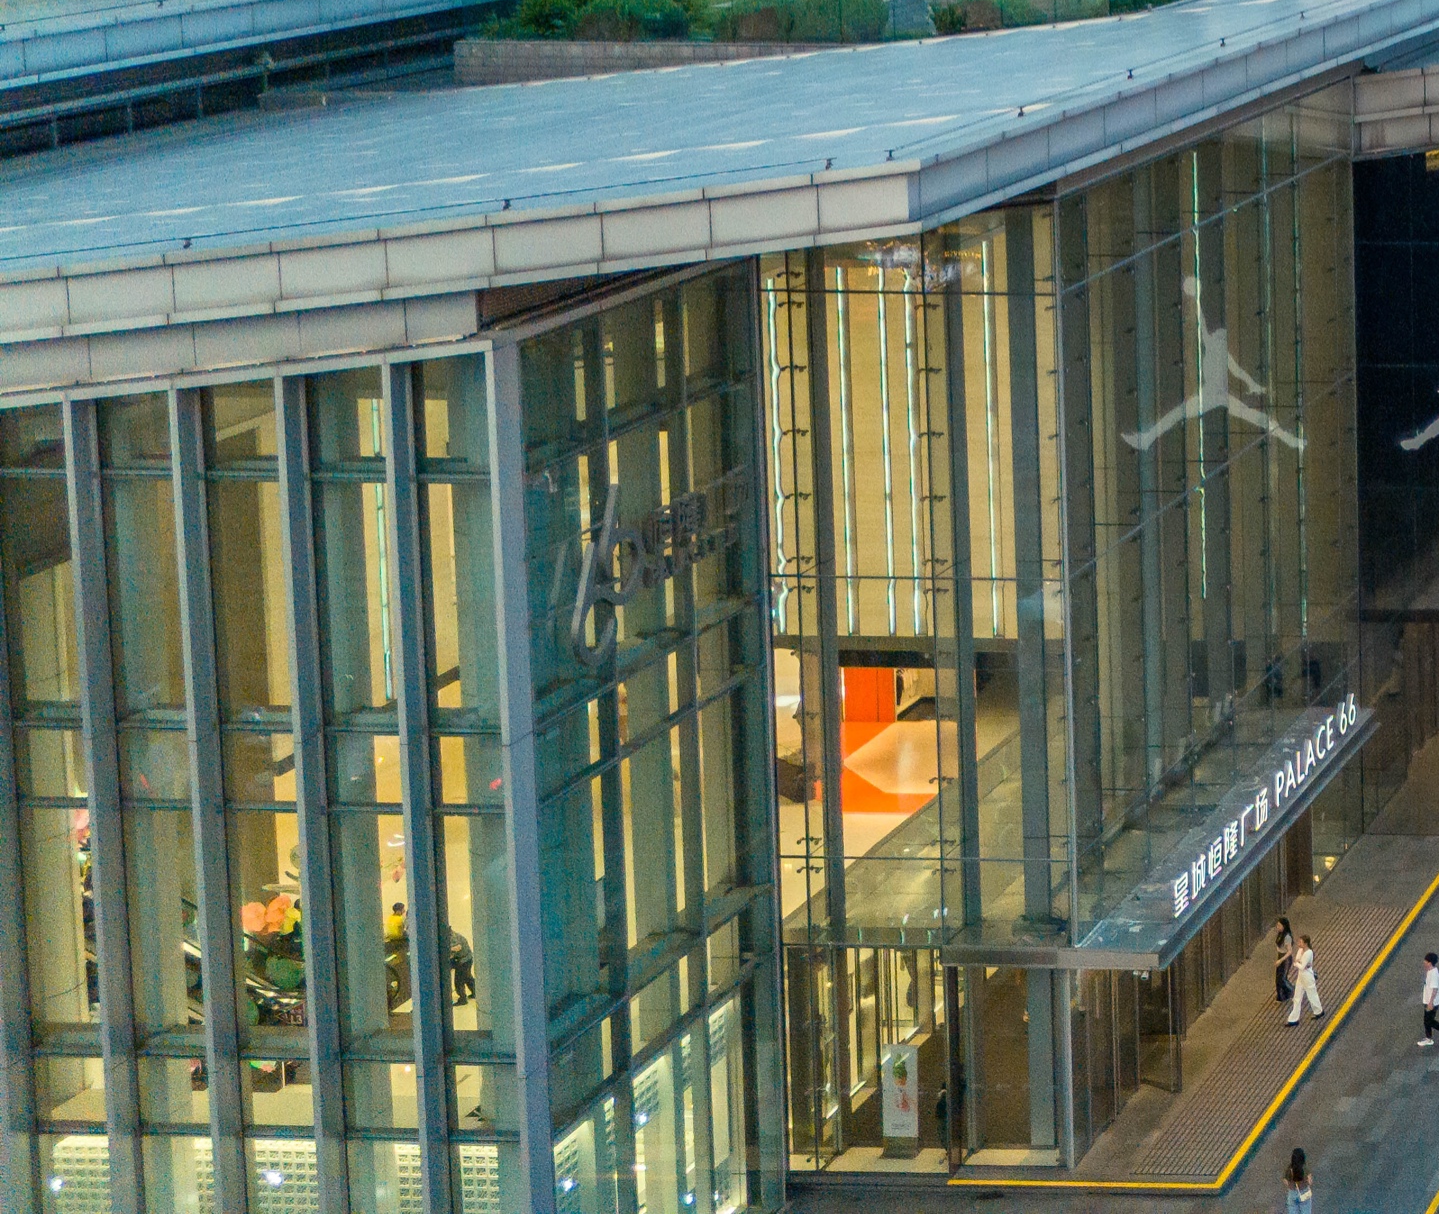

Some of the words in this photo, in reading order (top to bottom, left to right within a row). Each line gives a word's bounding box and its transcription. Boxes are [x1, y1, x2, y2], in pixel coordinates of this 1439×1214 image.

[1173, 786, 1269, 918] 皇城恒隆广场
[1274, 715, 1335, 808] PALACE
[1337, 692, 1357, 736] 66
